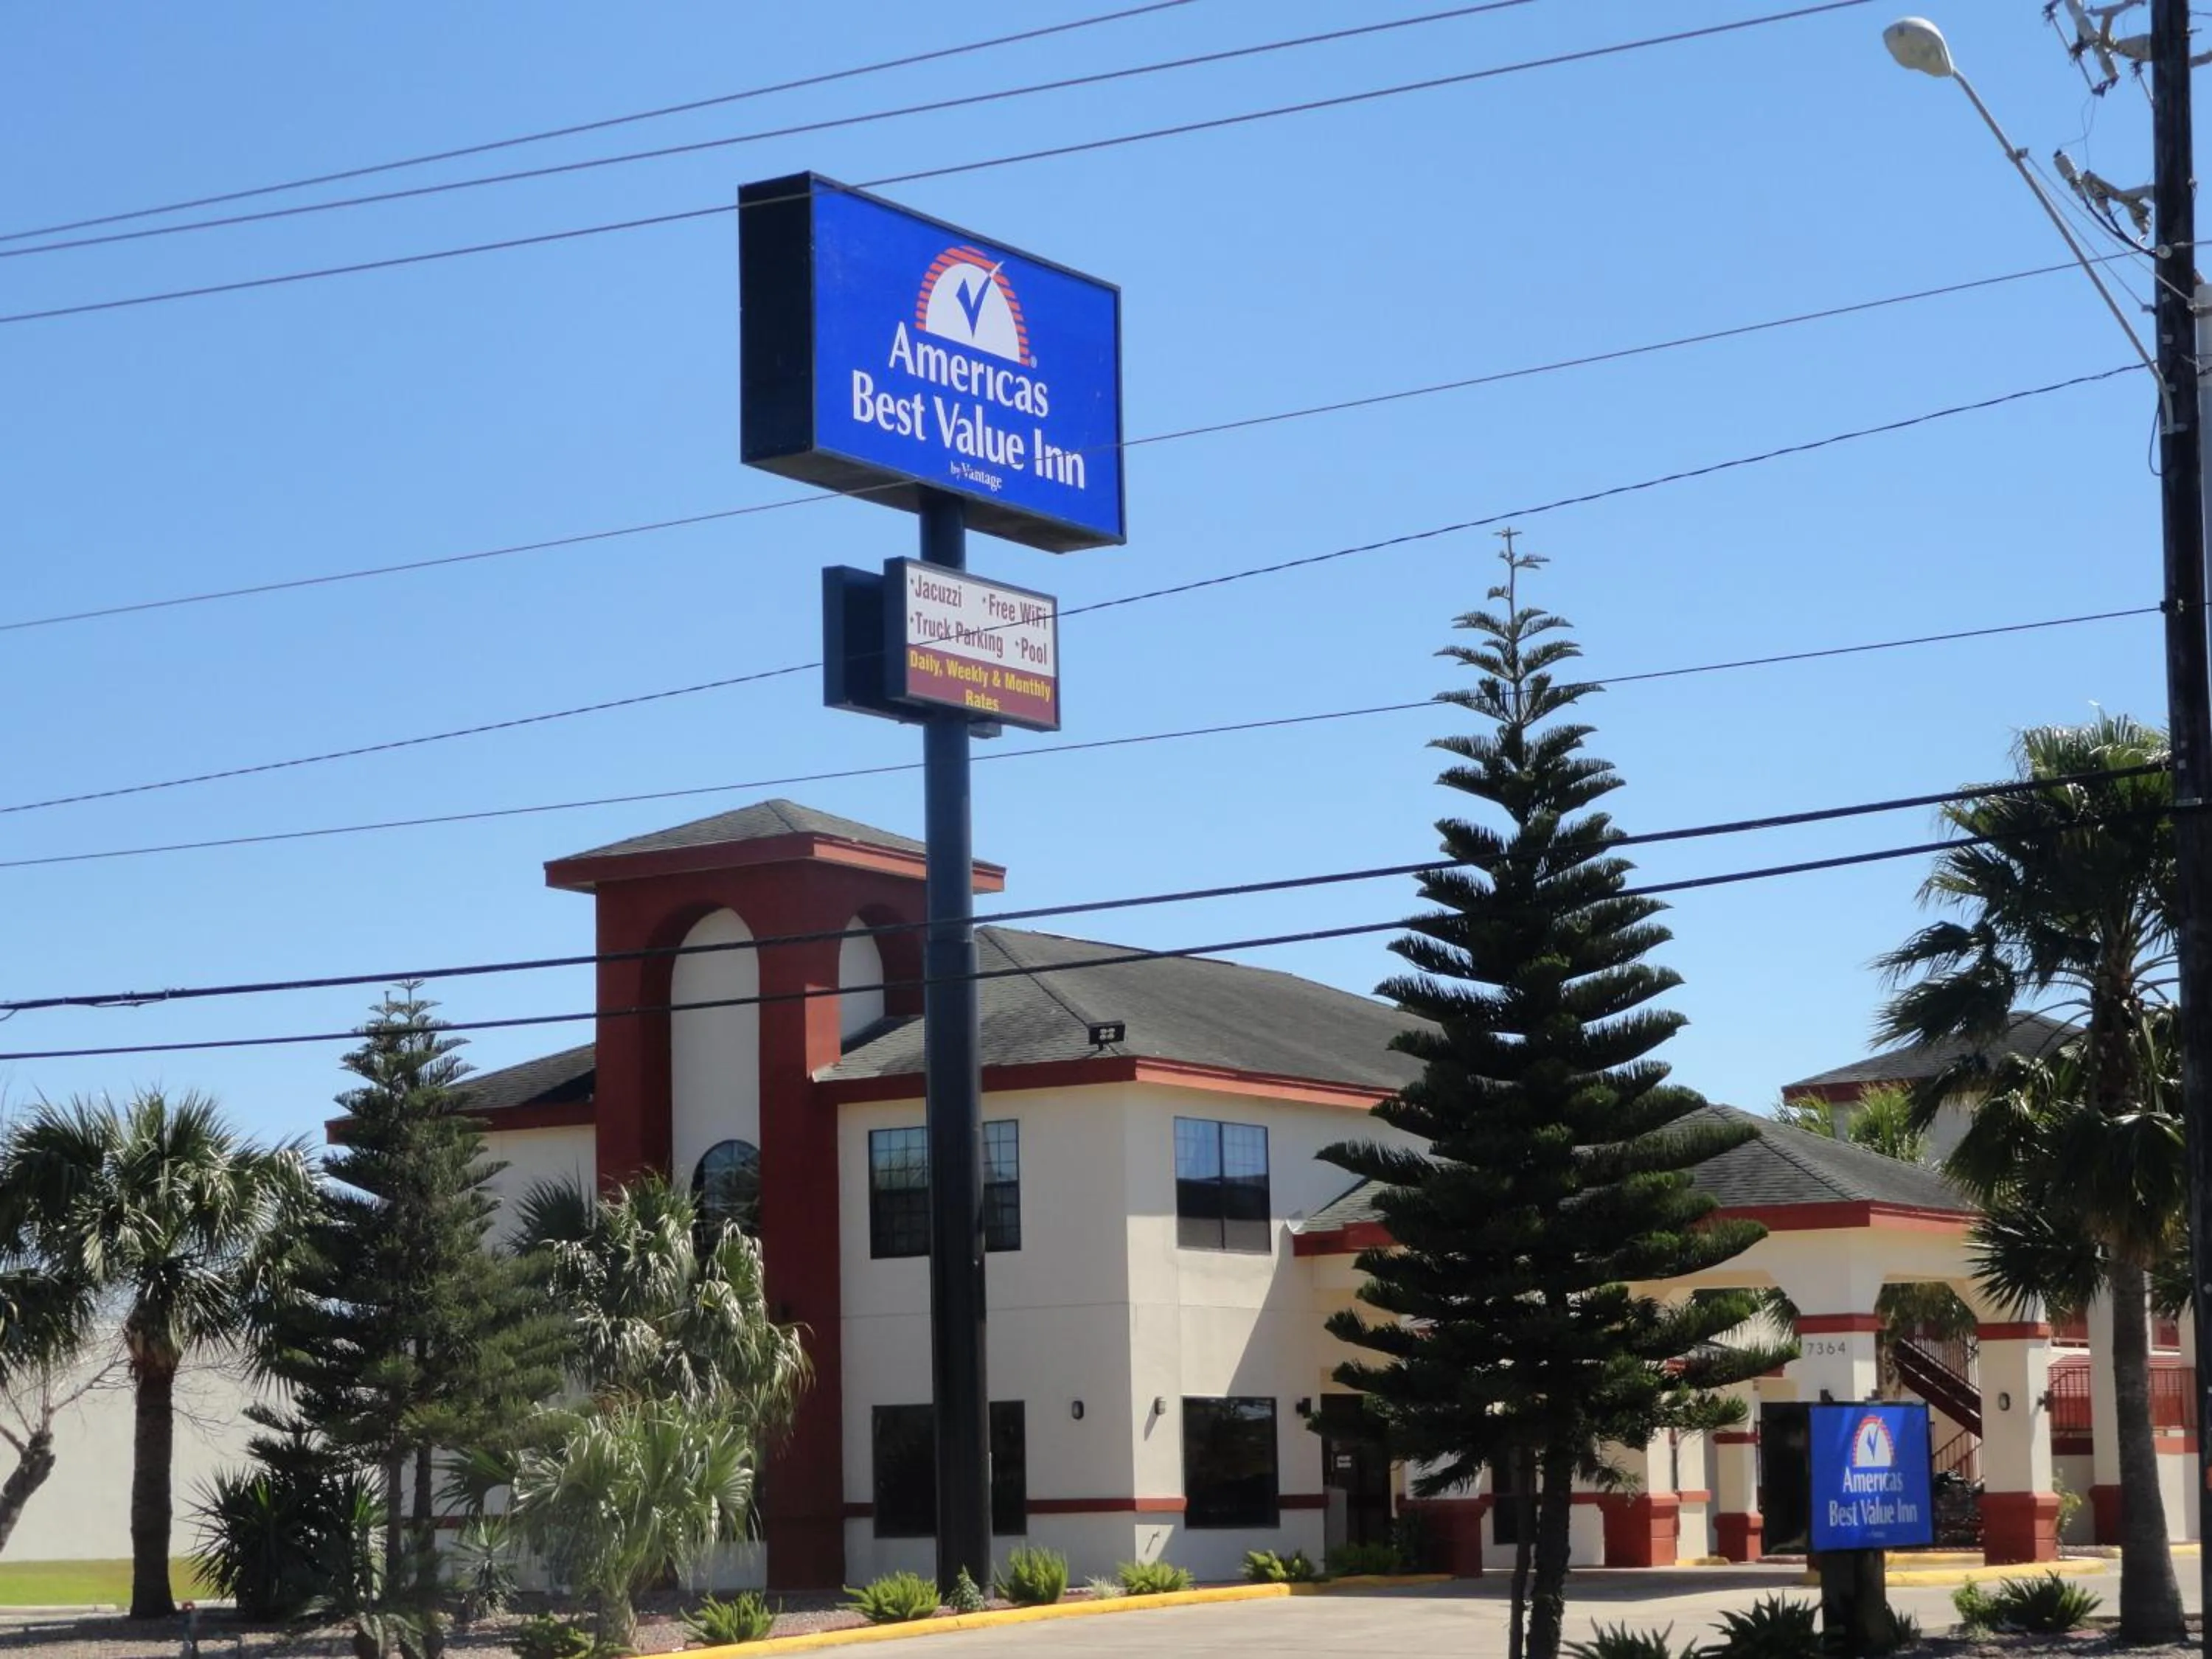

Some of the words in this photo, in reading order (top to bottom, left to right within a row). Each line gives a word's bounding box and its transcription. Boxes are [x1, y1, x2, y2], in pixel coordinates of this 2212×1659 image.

[888, 321, 1048, 417] Americas
[852, 369, 927, 441] Best
[933, 396, 1024, 470] Value
[1034, 428, 1085, 490] Inn
[961, 462, 1002, 492] Vantage
[915, 575, 962, 608] Jacuzzi
[989, 594, 1015, 621] Free
[1020, 601, 1047, 630] WiFi
[915, 612, 951, 641] Truck
[956, 621, 1004, 658] Parking
[1021, 638, 1048, 665] Pool
[909, 650, 943, 676] Daily,
[947, 658, 989, 687] Weekly
[992, 670, 1001, 687] &
[1005, 672, 1051, 703] Monthly
[964, 689, 1000, 712] Rates
[1806, 1340, 1846, 1355] 7364
[1843, 1467, 1904, 1492] Americas
[1829, 1500, 1858, 1526] Best
[1860, 1497, 1895, 1525] Value
[1897, 1498, 1918, 1523] Inn
